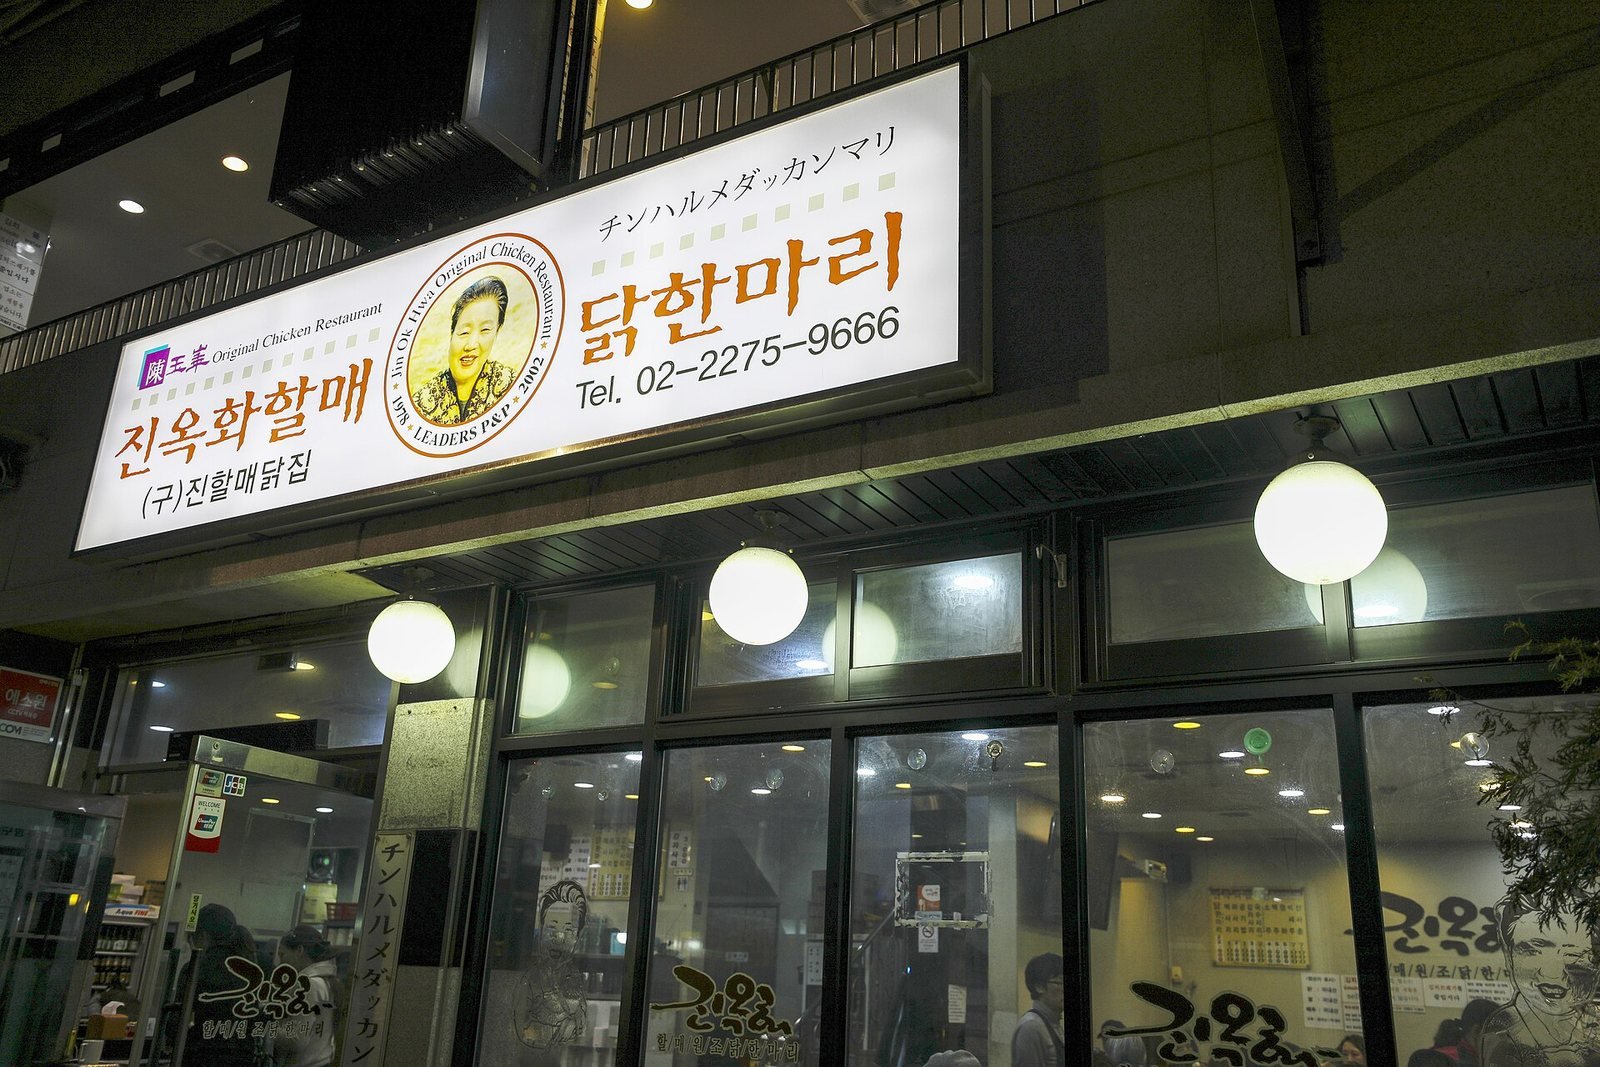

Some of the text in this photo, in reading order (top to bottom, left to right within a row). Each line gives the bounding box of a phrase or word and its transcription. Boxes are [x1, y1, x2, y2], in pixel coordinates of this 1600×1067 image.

[599, 126, 896, 242] チンハルメダッカンマリ
[391, 242, 554, 378] Jin Ok Hwa Original Chicken Restaurant
[580, 211, 903, 366] 닭한마리
[212, 302, 383, 364] Original Chicken Restaurant
[576, 306, 900, 409] Tel. 02-2275-9666
[391, 395, 410, 426] 1978
[518, 356, 545, 395] 2002
[114, 358, 373, 480] 진옥화할매
[413, 403, 511, 447] LEADERS P&P
[141, 449, 313, 519] (구)진할매닭집
[198, 800, 221, 809] WELCOME
[225, 780, 244, 790] JCB
[351, 843, 406, 1063] チンハルメダッカン
